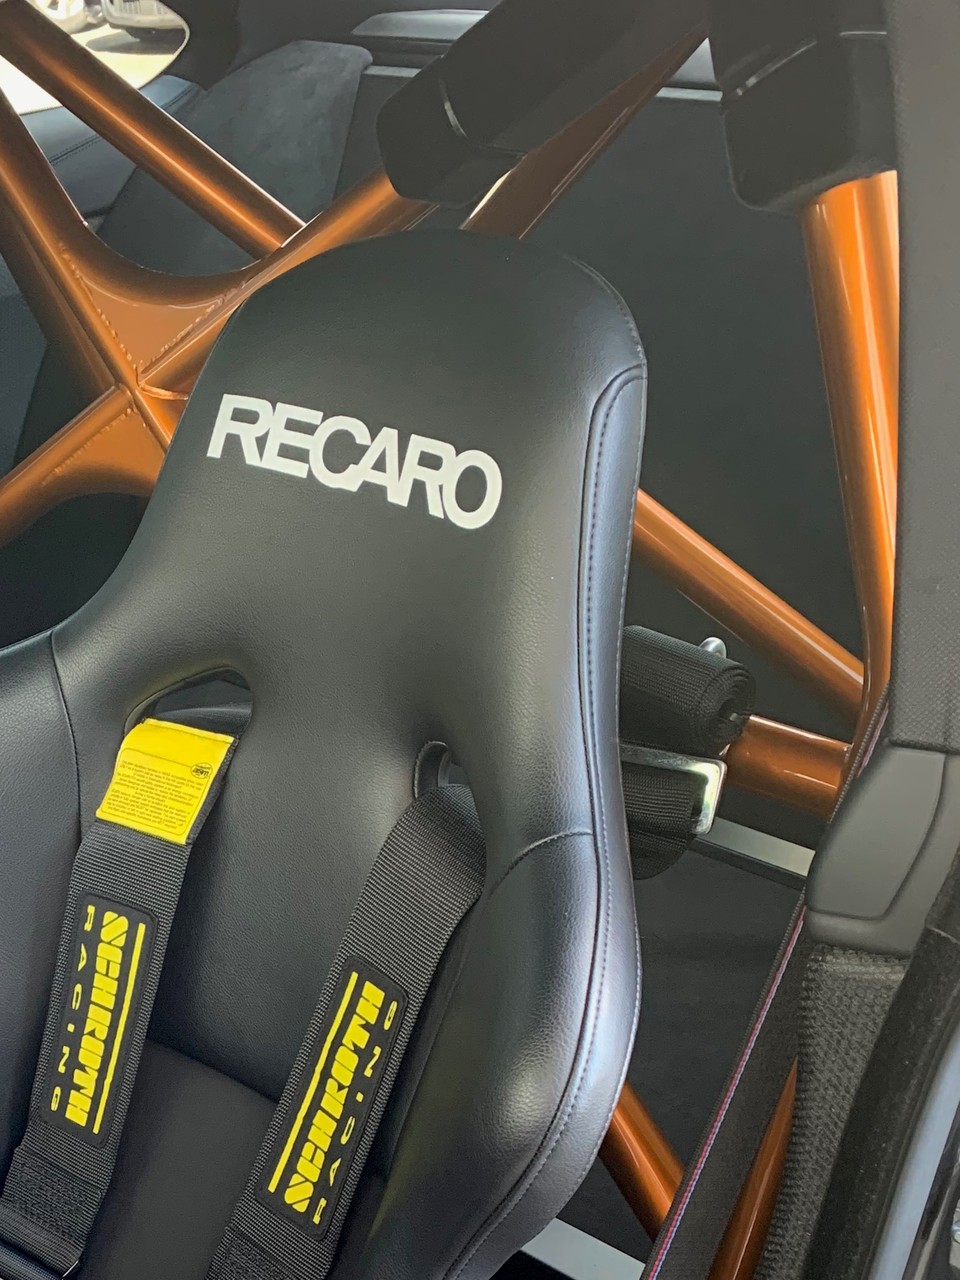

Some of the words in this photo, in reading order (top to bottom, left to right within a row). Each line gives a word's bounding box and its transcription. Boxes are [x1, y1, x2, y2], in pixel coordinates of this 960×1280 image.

[207, 394, 502, 529] RECARO
[51, 905, 95, 1111] RACING
[65, 911, 128, 1127] SCHROTH
[284, 981, 385, 1213] SCHROTH
[313, 1000, 397, 1225] RACING
